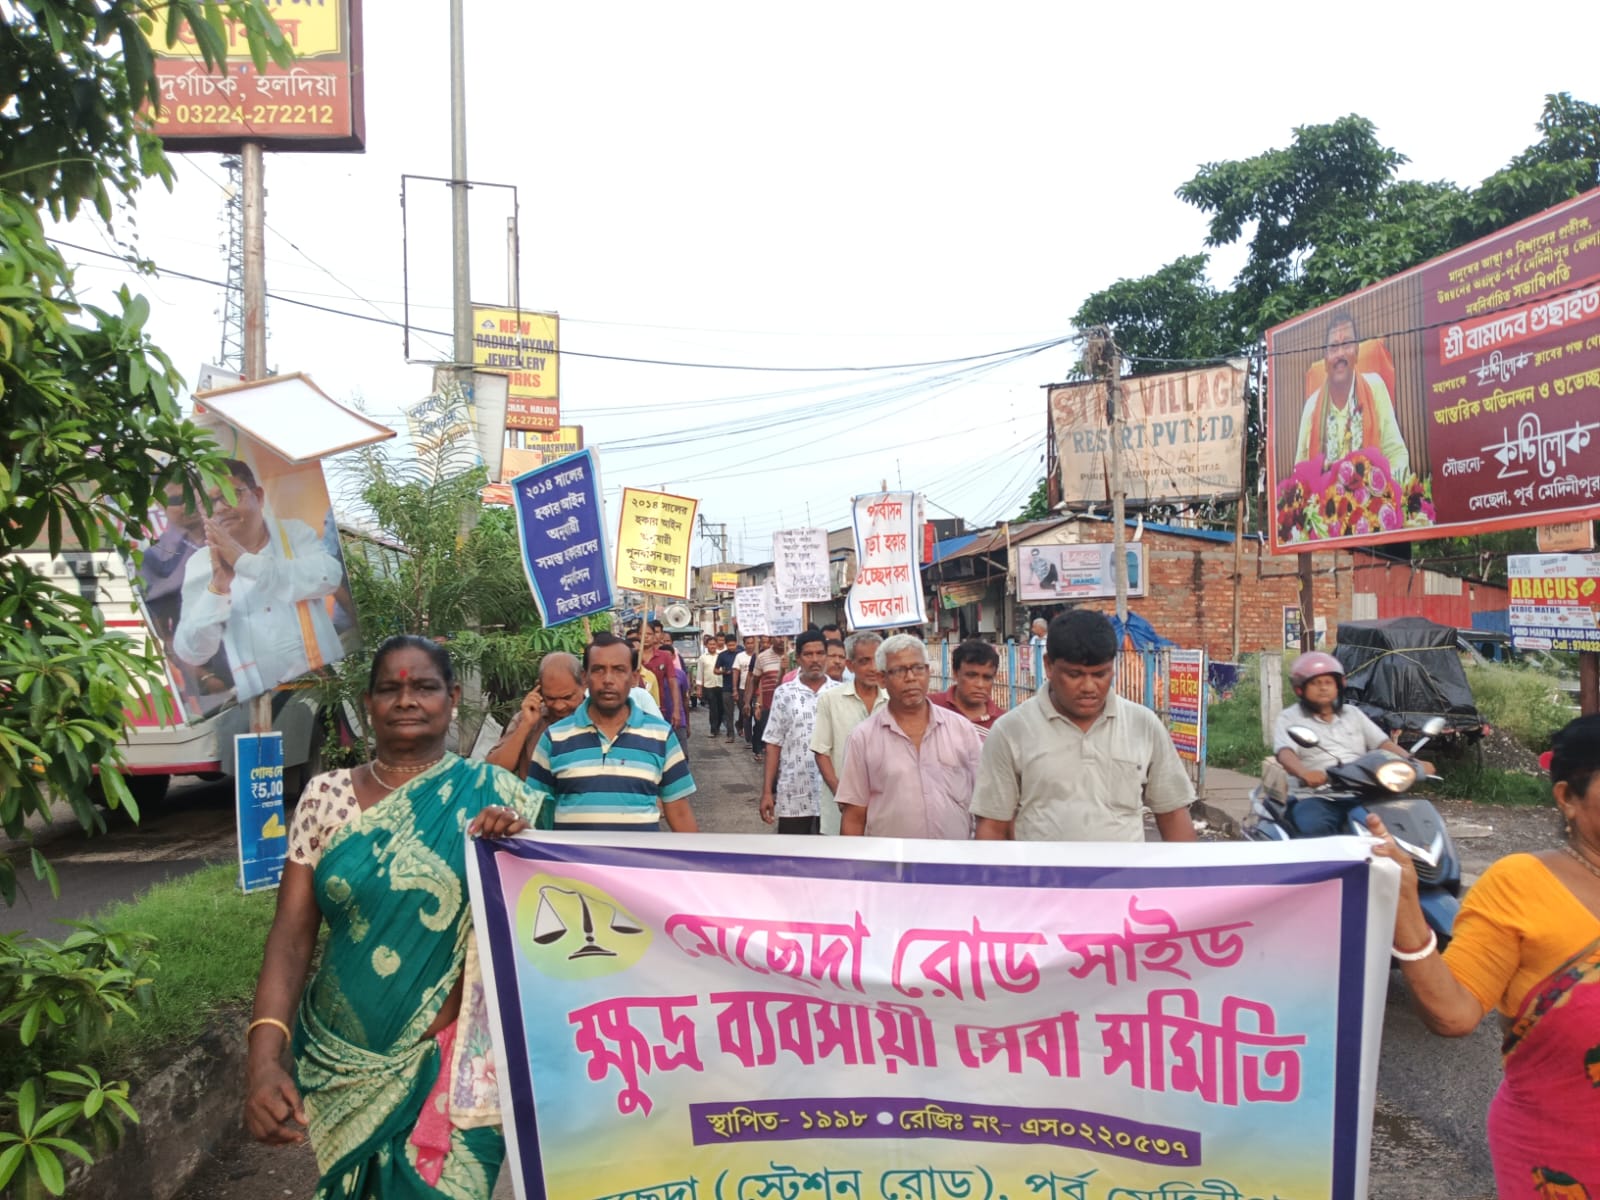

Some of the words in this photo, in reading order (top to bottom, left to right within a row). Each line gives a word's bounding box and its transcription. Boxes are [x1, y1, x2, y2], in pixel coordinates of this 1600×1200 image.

[158, 65, 246, 101] দুর্গাচক,
[256, 67, 336, 97] হলদিয়া
[176, 105, 333, 124] 03224-272212
[499, 319, 530, 335] NEW
[1444, 326, 1464, 359] শ্রী
[503, 371, 541, 387] ORKS
[1482, 388, 1534, 413] অভিনন্দন
[1538, 382, 1549, 398] ও
[526, 479, 553, 499] ২০১৪
[554, 467, 584, 487] সালের
[1469, 490, 1512, 511] মেছেদা,
[1513, 481, 1536, 506] পূর্ব
[1538, 474, 1600, 500] মেদিনীপুর
[560, 492, 586, 510] আইন
[631, 498, 659, 509] ২০১৪
[661, 502, 688, 514] সালের
[660, 518, 682, 530] আইন
[893, 562, 910, 582] করা
[1511, 578, 1579, 600] ABACUS
[859, 598, 893, 618] চলবে
[664, 909, 871, 994] মেছেদা
[891, 914, 1049, 1002] রোড
[1057, 895, 1255, 986] সাইড
[567, 994, 705, 1118] ক্ষুদ্র
[710, 990, 938, 1074] ব্যবসায়ী
[954, 1010, 1081, 1078] সেবা
[1095, 988, 1306, 1107] সমিতি
[799, 1109, 868, 1130] ১৯৯৮
[899, 1104, 963, 1131] রেজিঃ
[1019, 1118, 1189, 1159] এস০২২০৫৩৭
